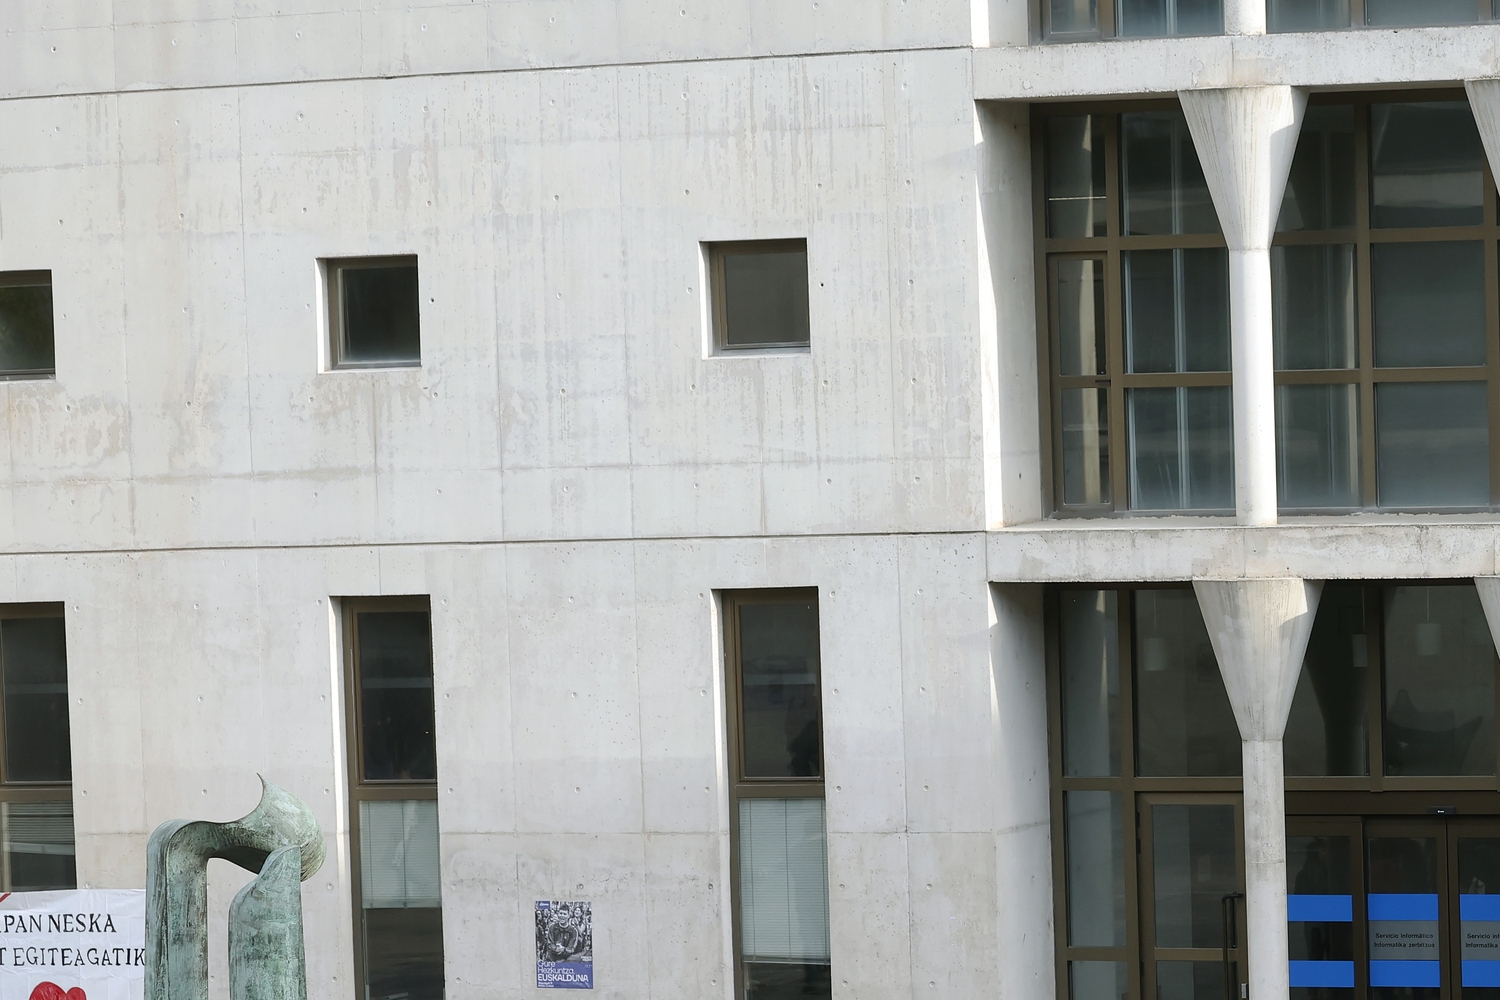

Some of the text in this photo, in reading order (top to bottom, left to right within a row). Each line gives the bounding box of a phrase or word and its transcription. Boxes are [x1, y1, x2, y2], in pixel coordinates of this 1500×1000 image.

[0, 914, 117, 933] PAN NESKA
[13, 946, 146, 967] EGITEAGATIK
[538, 974, 589, 982] EUSKALDUNA
